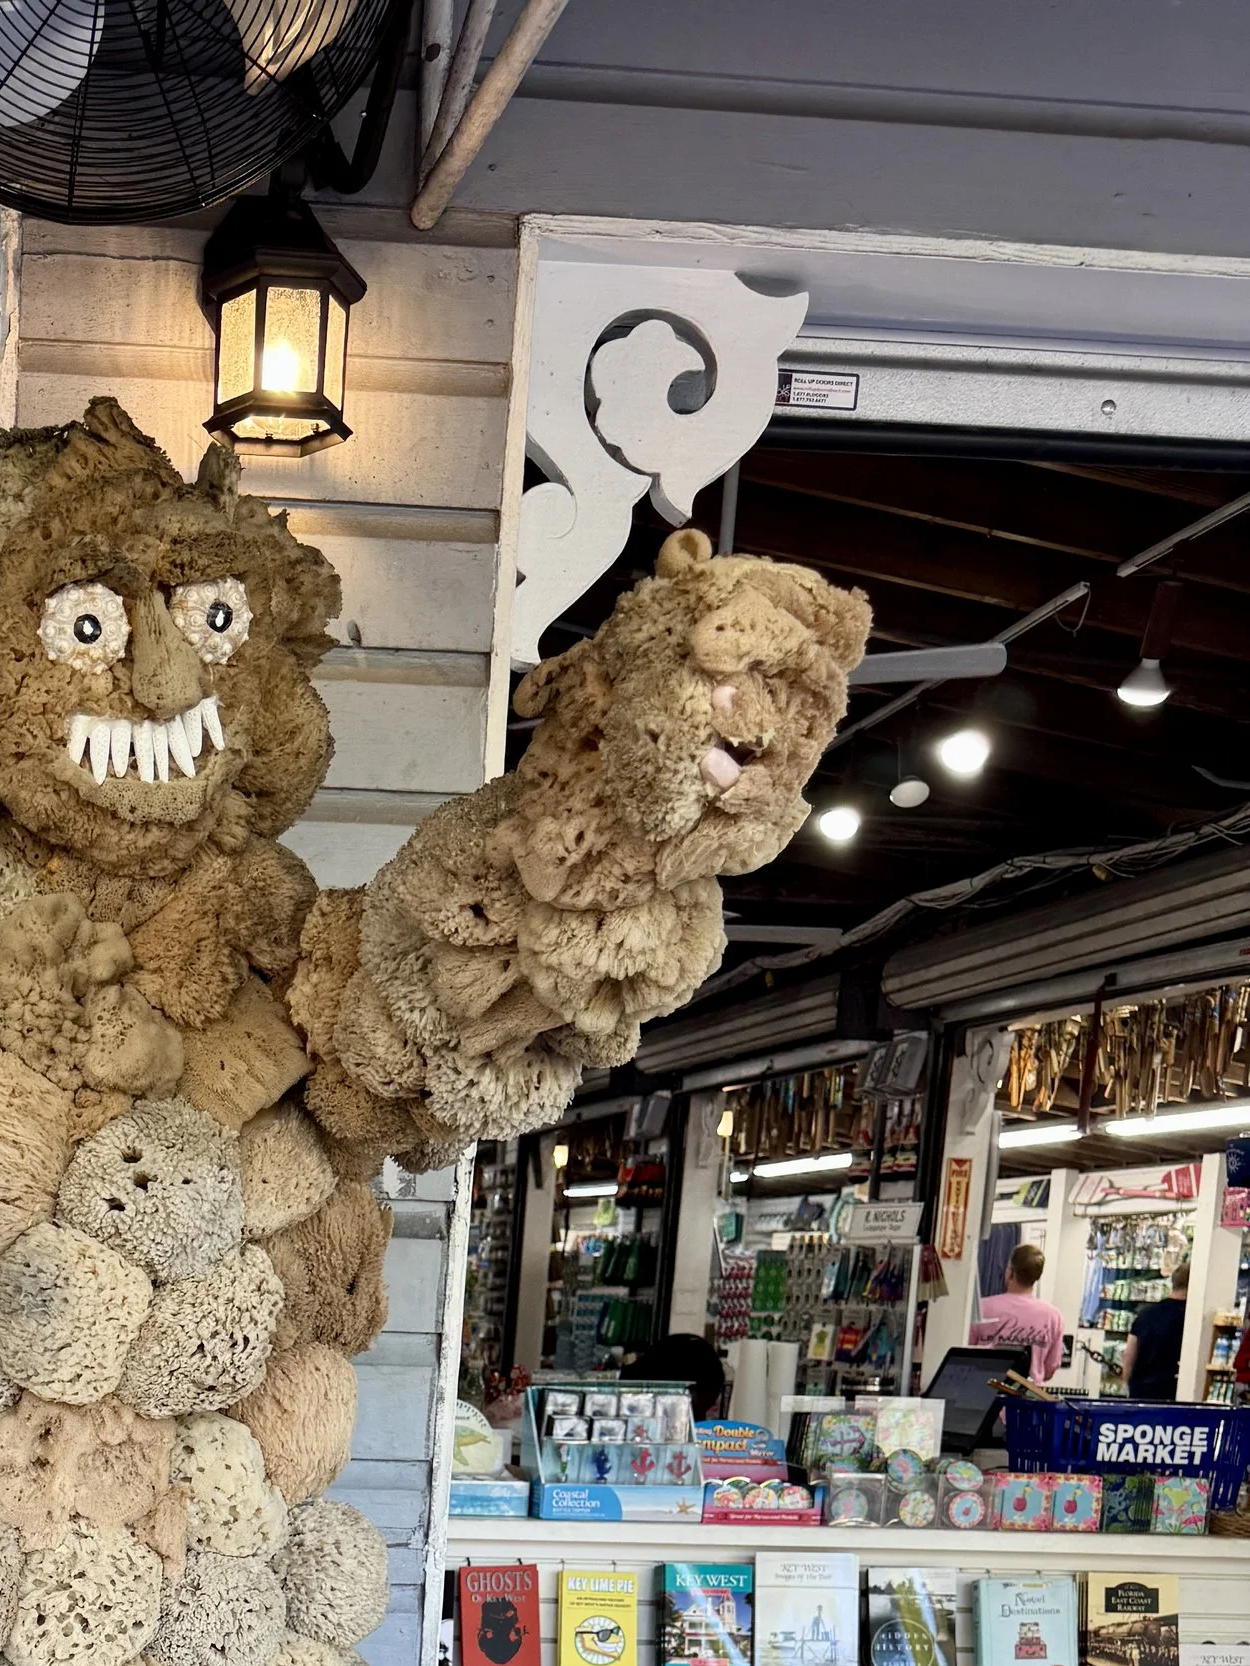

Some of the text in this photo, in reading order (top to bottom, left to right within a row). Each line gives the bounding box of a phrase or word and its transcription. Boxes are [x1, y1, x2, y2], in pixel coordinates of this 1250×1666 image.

[873, 1209, 906, 1223] NICHOLS
[713, 1425, 755, 1438] Double
[1098, 1422, 1209, 1446] SPONGE
[696, 1440, 747, 1455] mpact
[750, 1449, 775, 1457] Mirror
[1096, 1442, 1207, 1466] MARKET
[552, 1489, 589, 1499] Coastal
[552, 1498, 600, 1508] Collection
[800, 1564, 828, 1573] WEST
[466, 1570, 532, 1592] GHOSTS
[567, 1577, 634, 1593] KEY LIME PIE
[676, 1574, 748, 1587] KEY WEST
[1014, 1591, 1046, 1606] Novel
[1129, 1597, 1152, 1605] COAST
[1000, 1604, 1061, 1618] Destinations
[1117, 1604, 1145, 1612] RAILWAY
[879, 1632, 929, 1640] HIDDEN
[874, 1643, 930, 1651] HISTORY
[1200, 1655, 1245, 1665] KEY WEST
